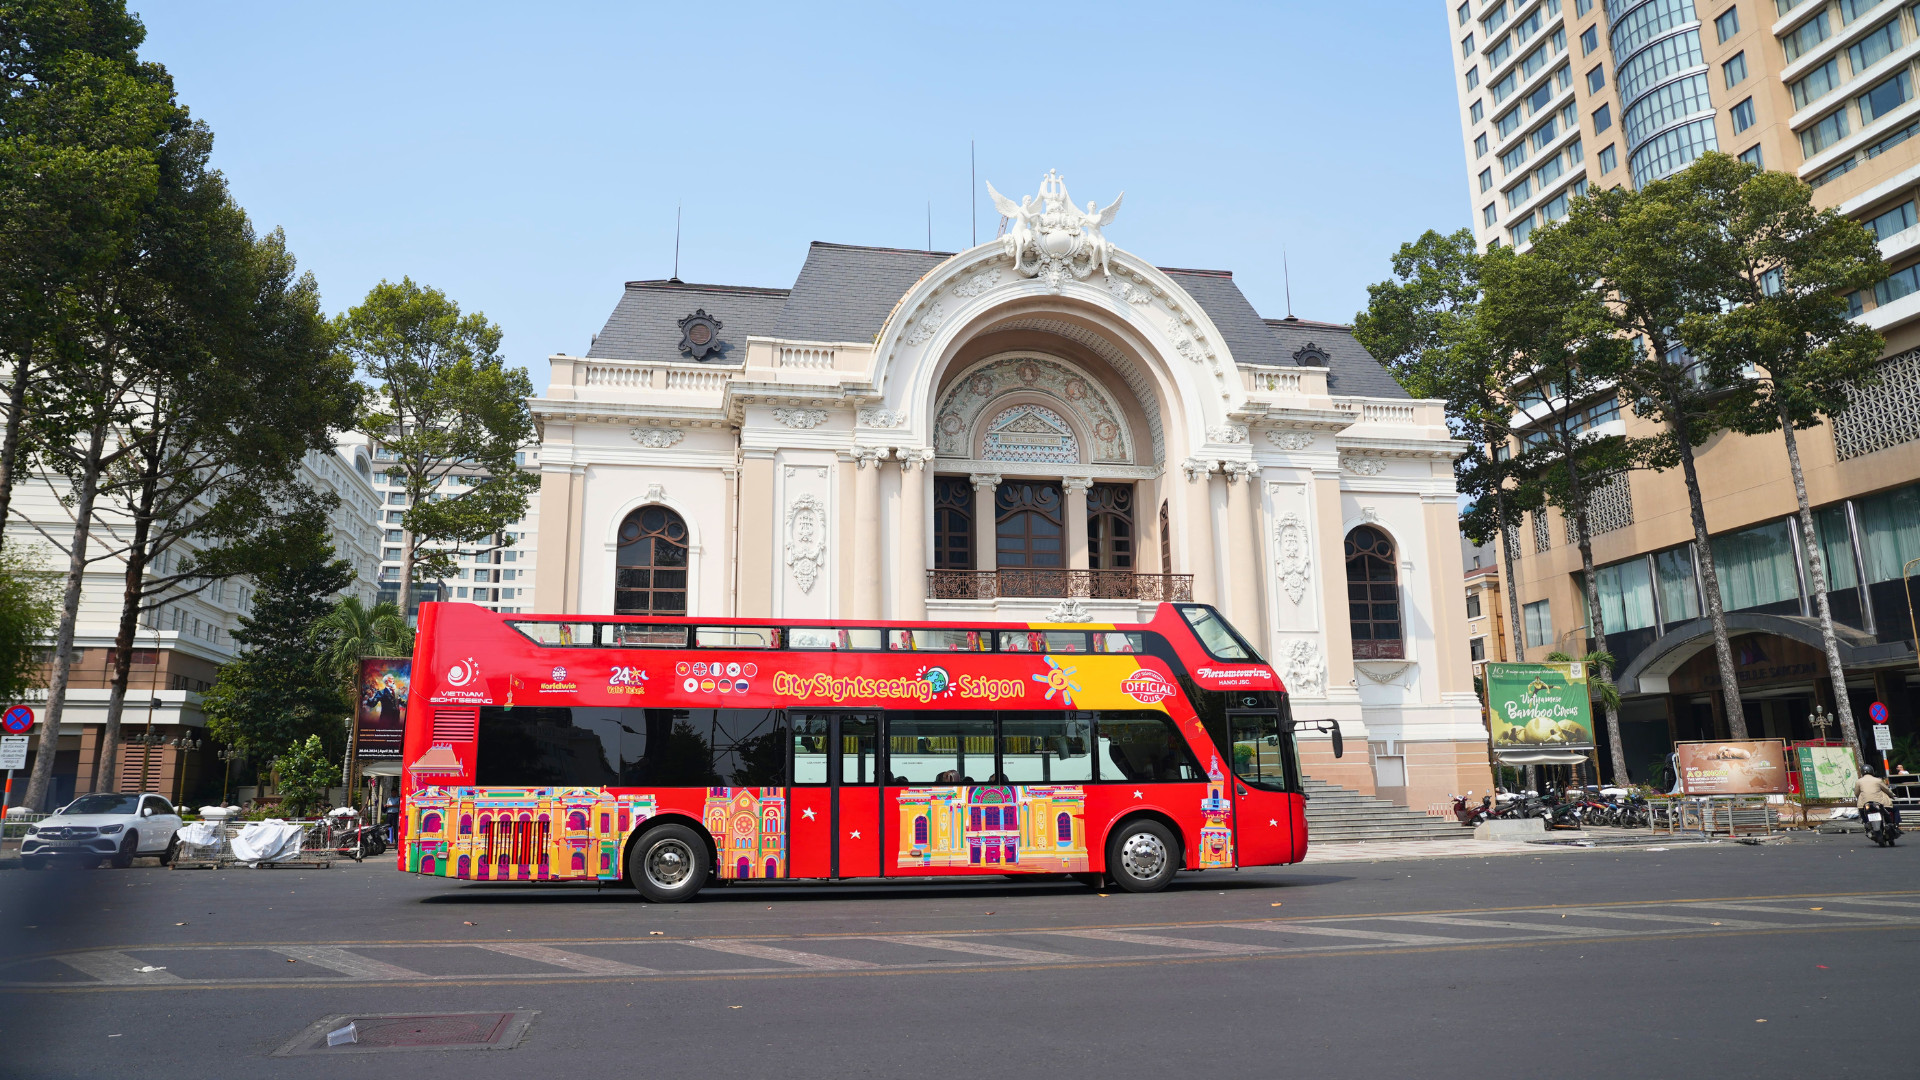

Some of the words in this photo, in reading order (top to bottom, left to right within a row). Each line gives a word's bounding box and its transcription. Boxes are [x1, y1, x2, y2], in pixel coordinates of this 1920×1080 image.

[609, 666, 631, 685] 24
[773, 671, 812, 700] City
[814, 673, 932, 702] Sightseeing
[959, 674, 1024, 701] Saigon
[1126, 682, 1173, 695] OFFICIAL
[1139, 694, 1161, 702] TOUR
[1520, 692, 1562, 705] Vietnamese
[1504, 701, 1553, 719] Bamboo
